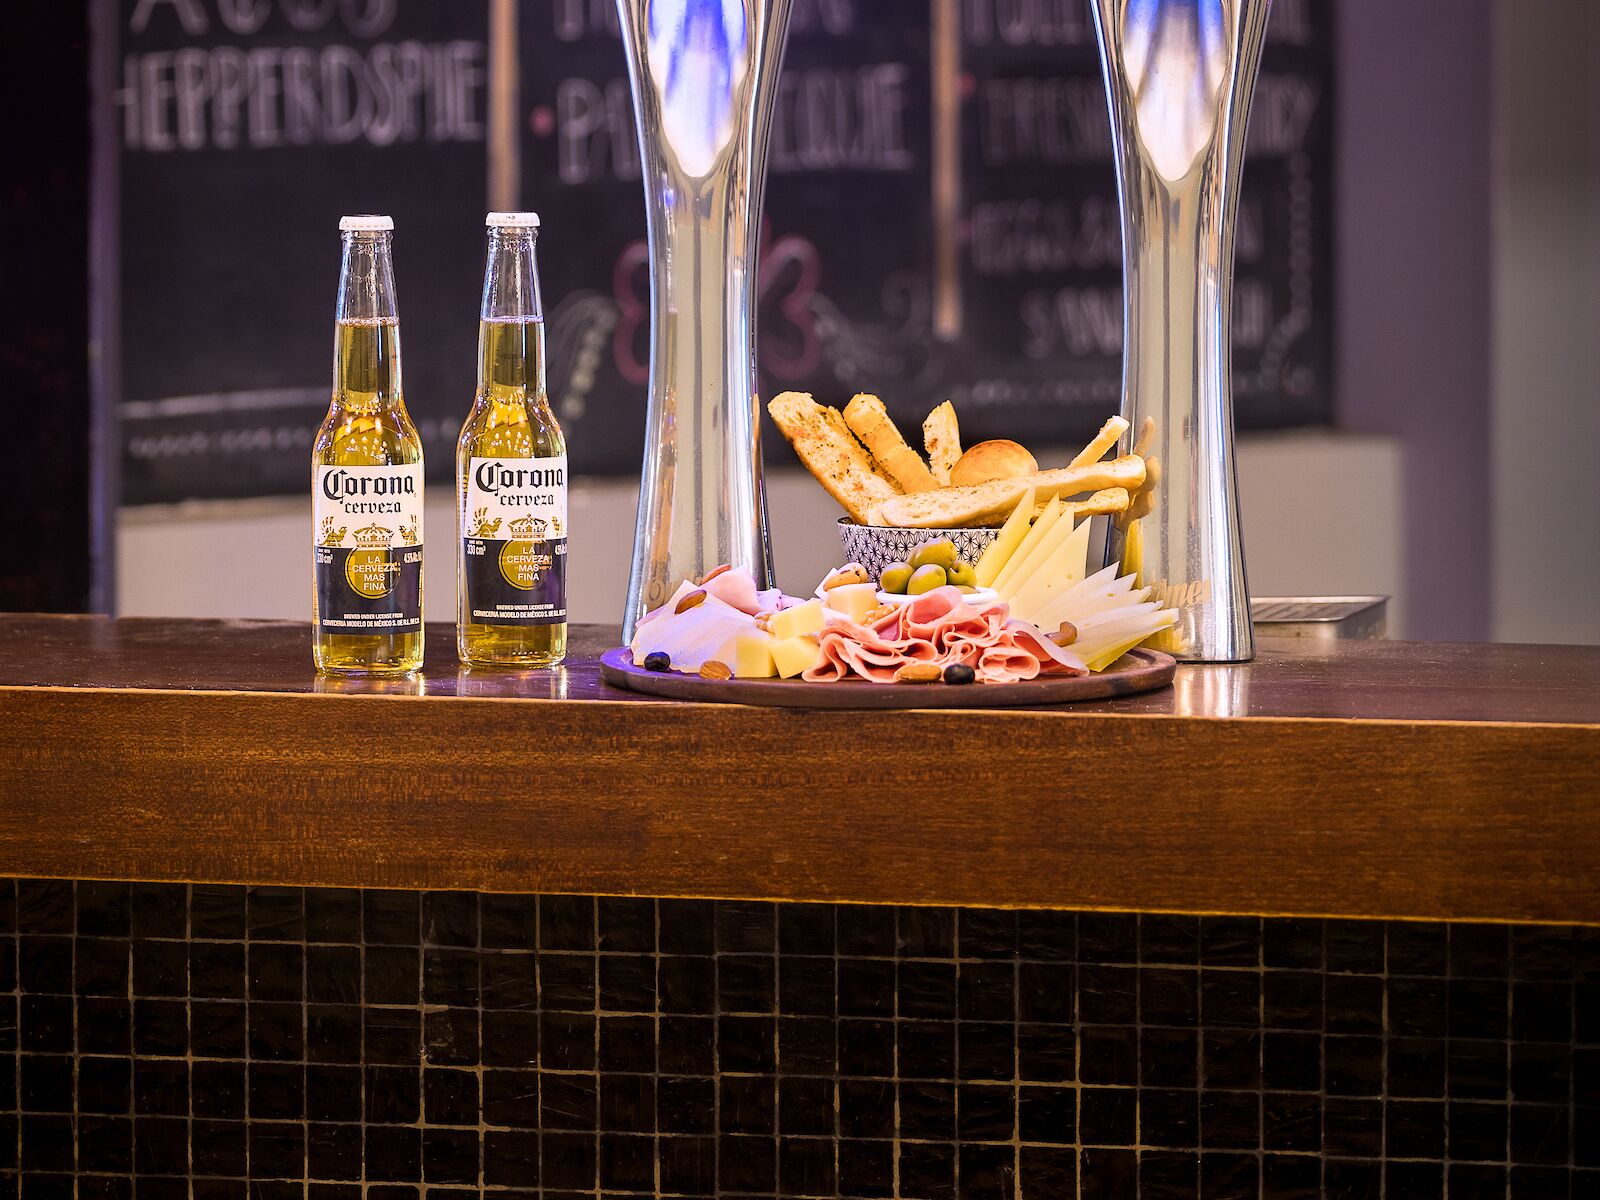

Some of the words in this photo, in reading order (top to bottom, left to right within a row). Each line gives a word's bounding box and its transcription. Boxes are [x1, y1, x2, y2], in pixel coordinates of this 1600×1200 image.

[475, 461, 565, 496] Corona
[322, 468, 414, 504] Corona
[499, 494, 555, 506] cerveza
[344, 501, 402, 514] cerveza
[522, 547, 536, 555] LA
[367, 555, 381, 564] LA
[506, 555, 550, 564] CERVEZA
[352, 564, 398, 573] CERVEZA
[518, 564, 540, 573] MAS
[363, 573, 386, 582] MAS
[517, 573, 540, 581] FINA
[363, 582, 387, 591] FINA
